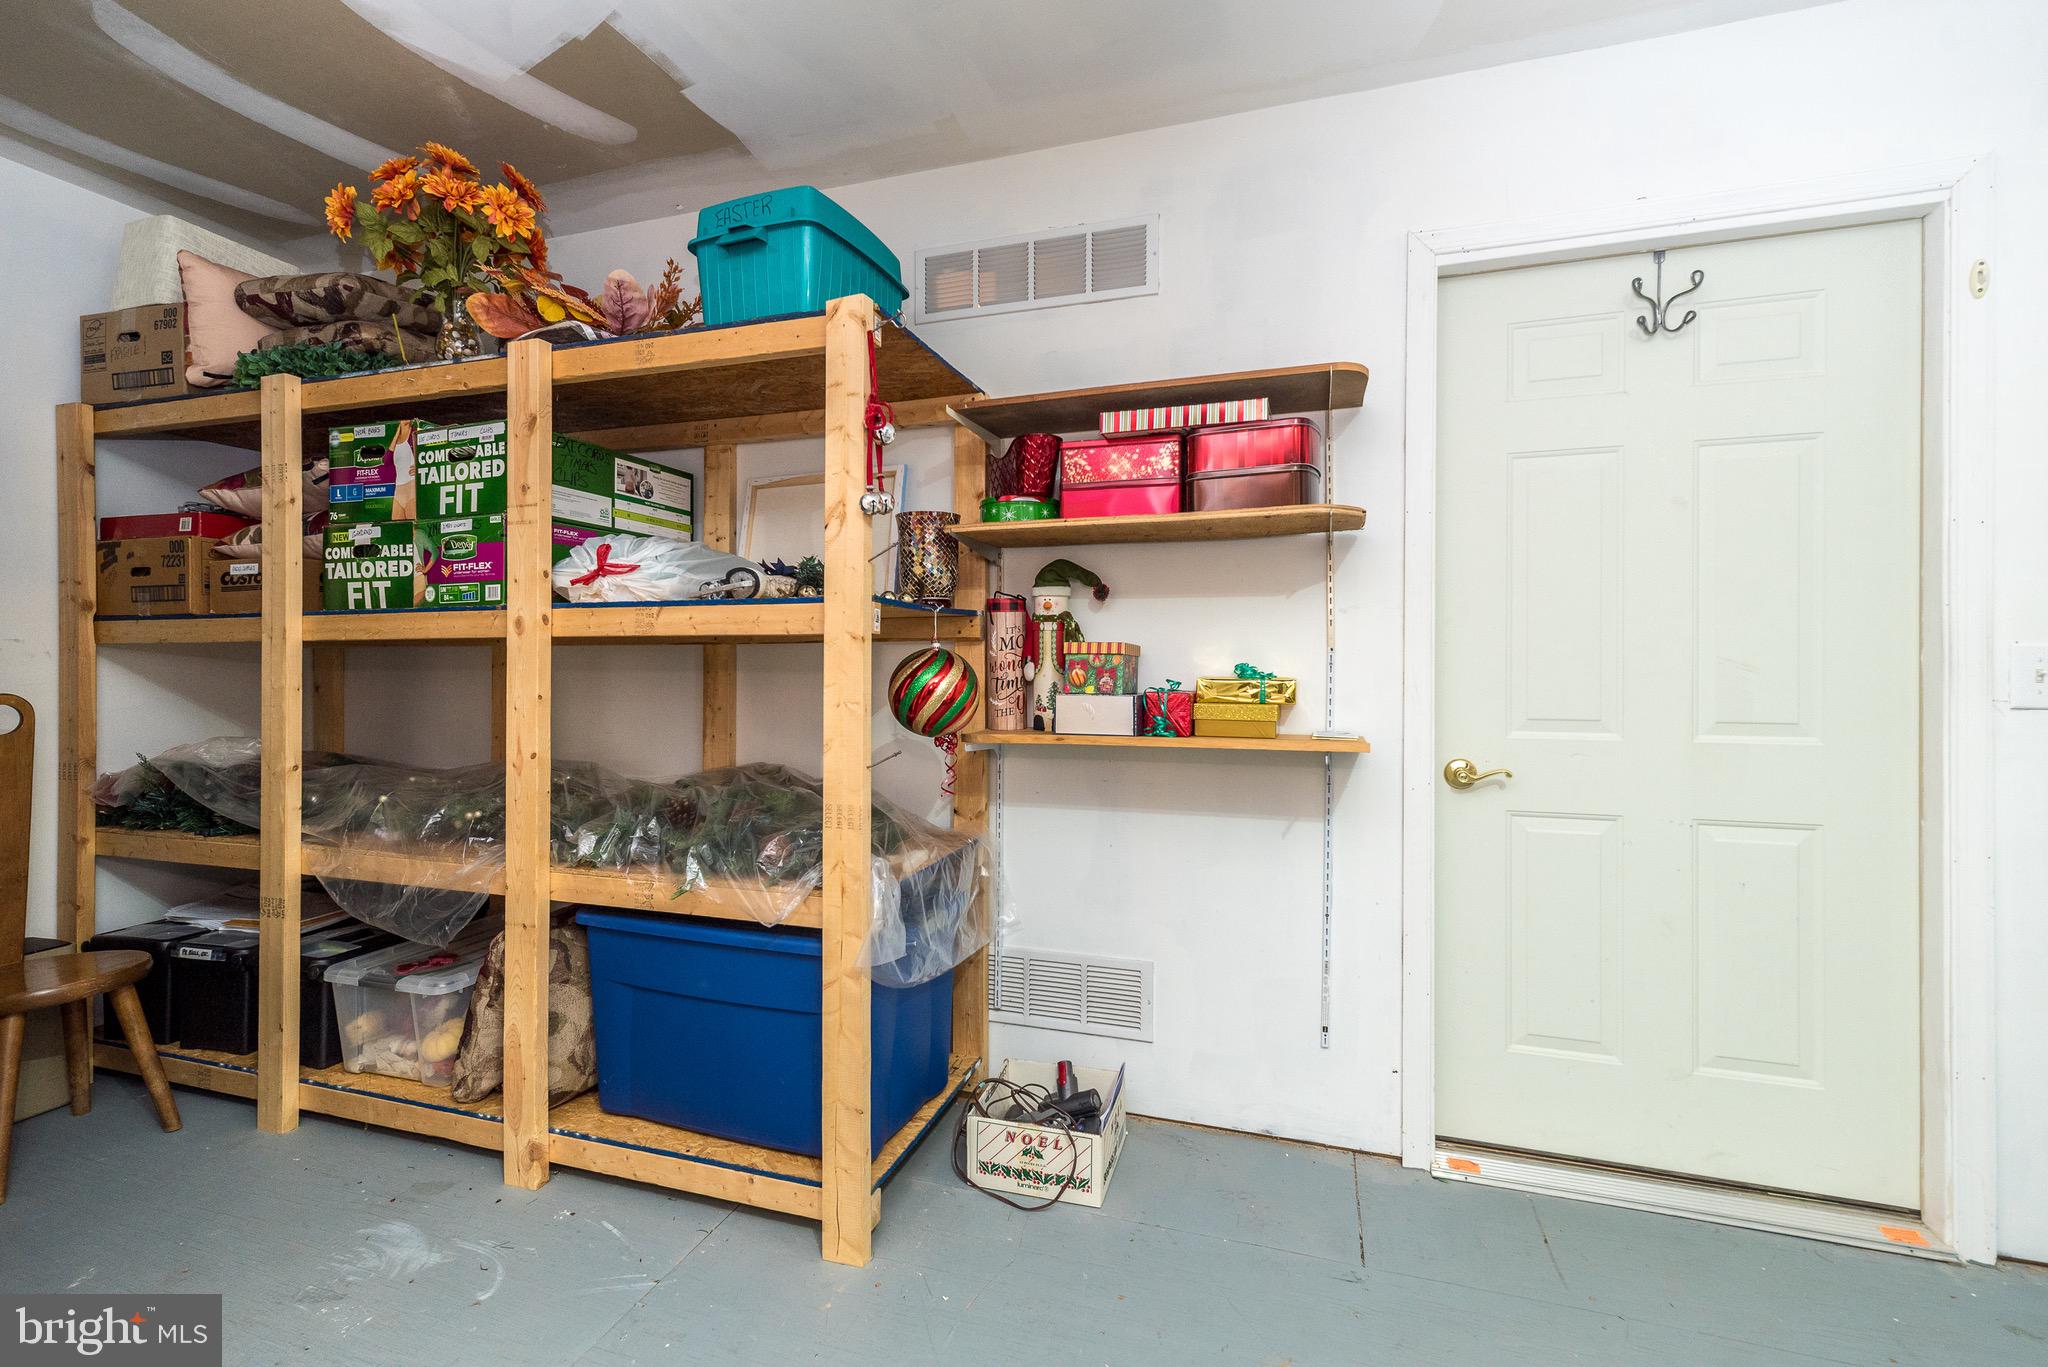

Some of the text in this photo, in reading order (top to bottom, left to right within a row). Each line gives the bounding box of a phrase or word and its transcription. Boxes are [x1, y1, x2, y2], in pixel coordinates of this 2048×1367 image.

[714, 194, 773, 228] EASTER
[163, 307, 178, 319] 000
[153, 319, 177, 330] 67902
[162, 352, 172, 363] 52
[418, 441, 505, 465] COMABLE
[417, 459, 506, 485] TAILORED
[439, 481, 484, 515] FIT
[329, 512, 338, 521] 76
[333, 533, 349, 542] NEW
[169, 540, 184, 553] 000
[324, 544, 414, 560] COMABLE
[161, 554, 185, 568] 72231
[324, 559, 414, 580] TAILORED
[347, 581, 392, 610] FIT
[1005, 625, 1021, 635] IT'S
[994, 707, 1015, 718] THE
[1004, 1130, 1063, 1151] NOEL
